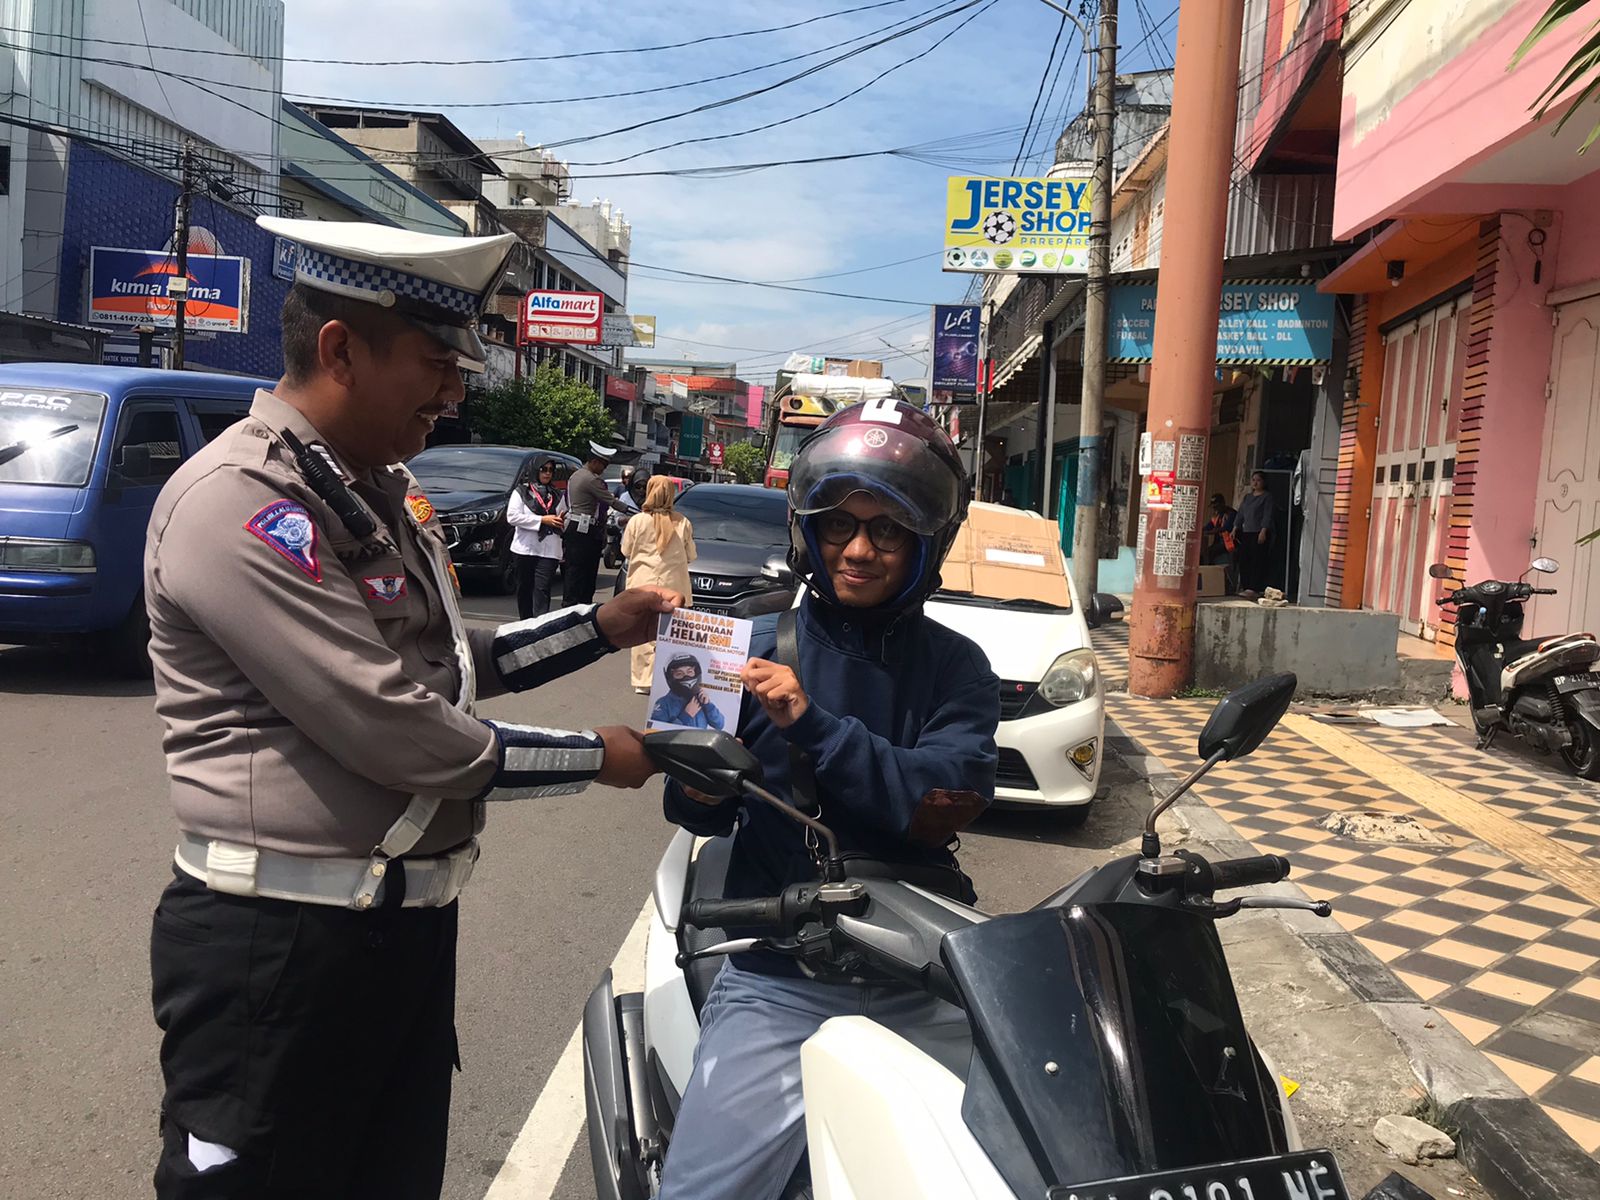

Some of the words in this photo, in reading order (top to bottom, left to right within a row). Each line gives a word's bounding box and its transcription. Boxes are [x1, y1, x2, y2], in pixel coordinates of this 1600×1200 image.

[951, 179, 1087, 230] JERSEY
[1020, 211, 1092, 233] SHOP
[111, 278, 162, 296] kimia
[531, 295, 596, 312] Alfamart
[1220, 293, 1253, 311] SEY
[1257, 292, 1300, 312] SHOP
[1117, 318, 1150, 328] SOCCER
[1218, 319, 1245, 329] OLLEY
[1247, 319, 1268, 329] BALL
[1277, 319, 1328, 329] BADMINTON
[1217, 332, 1244, 341] ASKET
[1246, 332, 1268, 341] BALL
[1276, 332, 1293, 341] DLL
[1217, 344, 1263, 355] RYDAY!!!
[1189, 486, 1198, 497] WC
[1157, 531, 1173, 541] AHLI
[1175, 532, 1186, 542] WC
[670, 627, 708, 644] HELM
[671, 619, 733, 637] PENGGUNAAN
